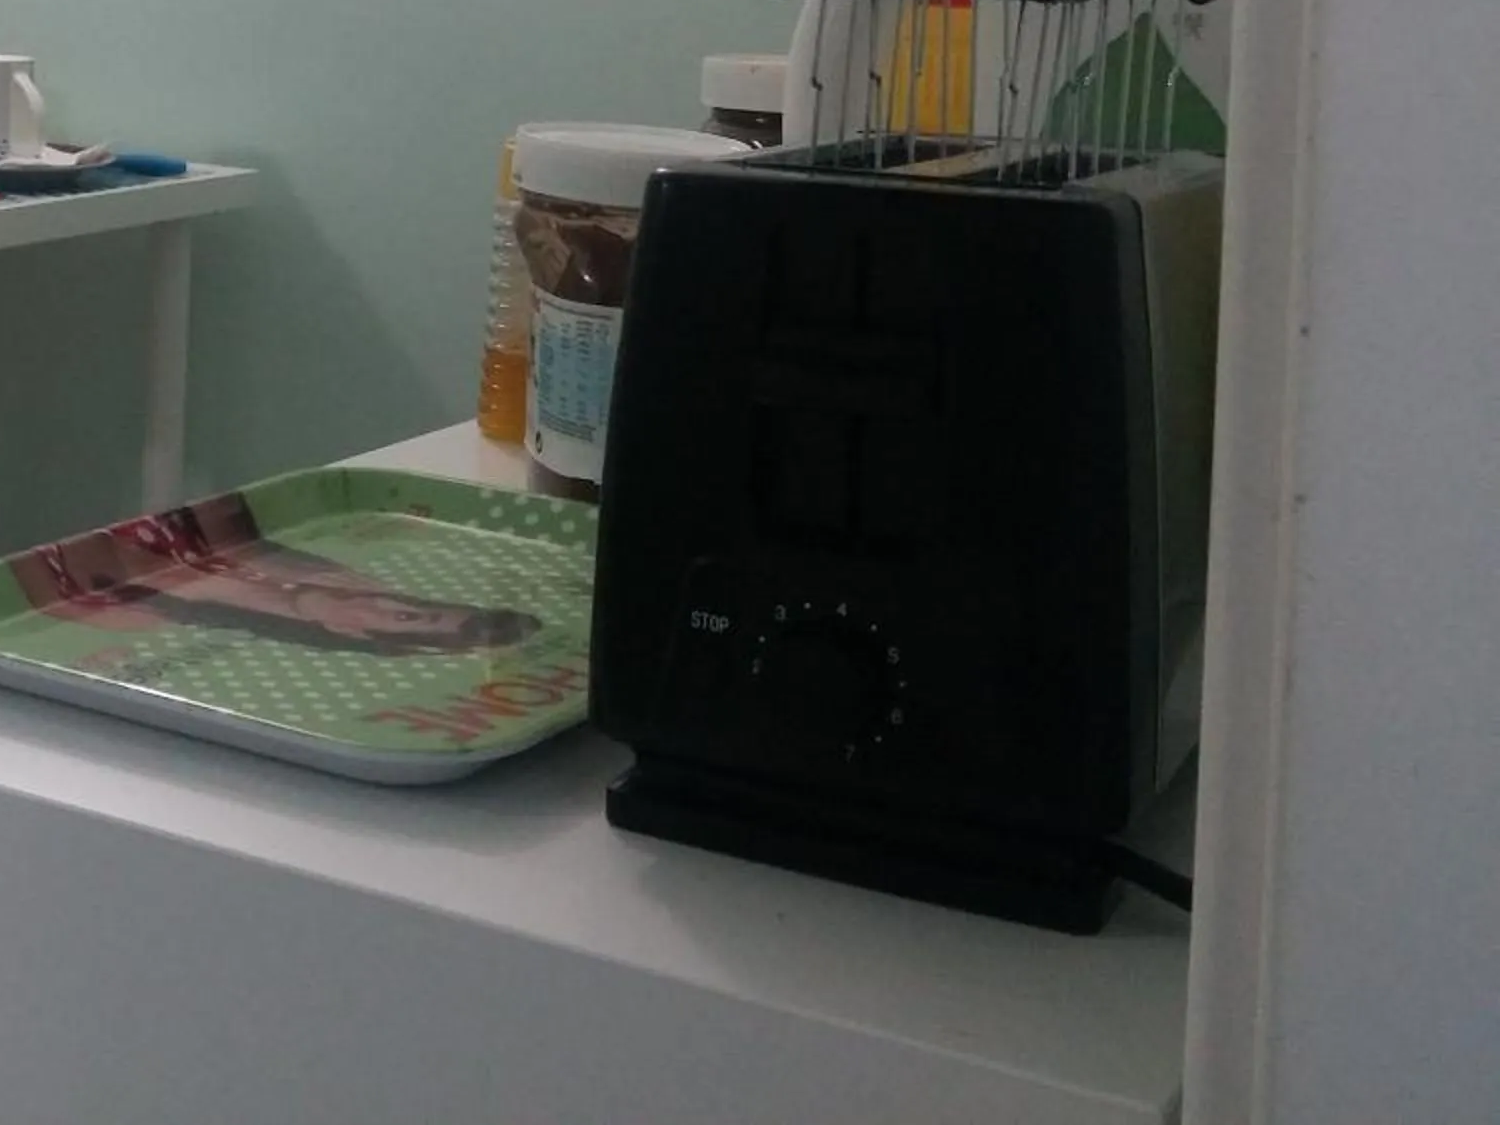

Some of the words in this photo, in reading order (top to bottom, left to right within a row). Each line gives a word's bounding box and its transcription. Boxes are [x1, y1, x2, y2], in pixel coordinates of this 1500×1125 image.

[773, 604, 788, 622] 3
[836, 602, 848, 617] 4
[690, 610, 730, 634] STOP
[886, 646, 901, 665] 5
